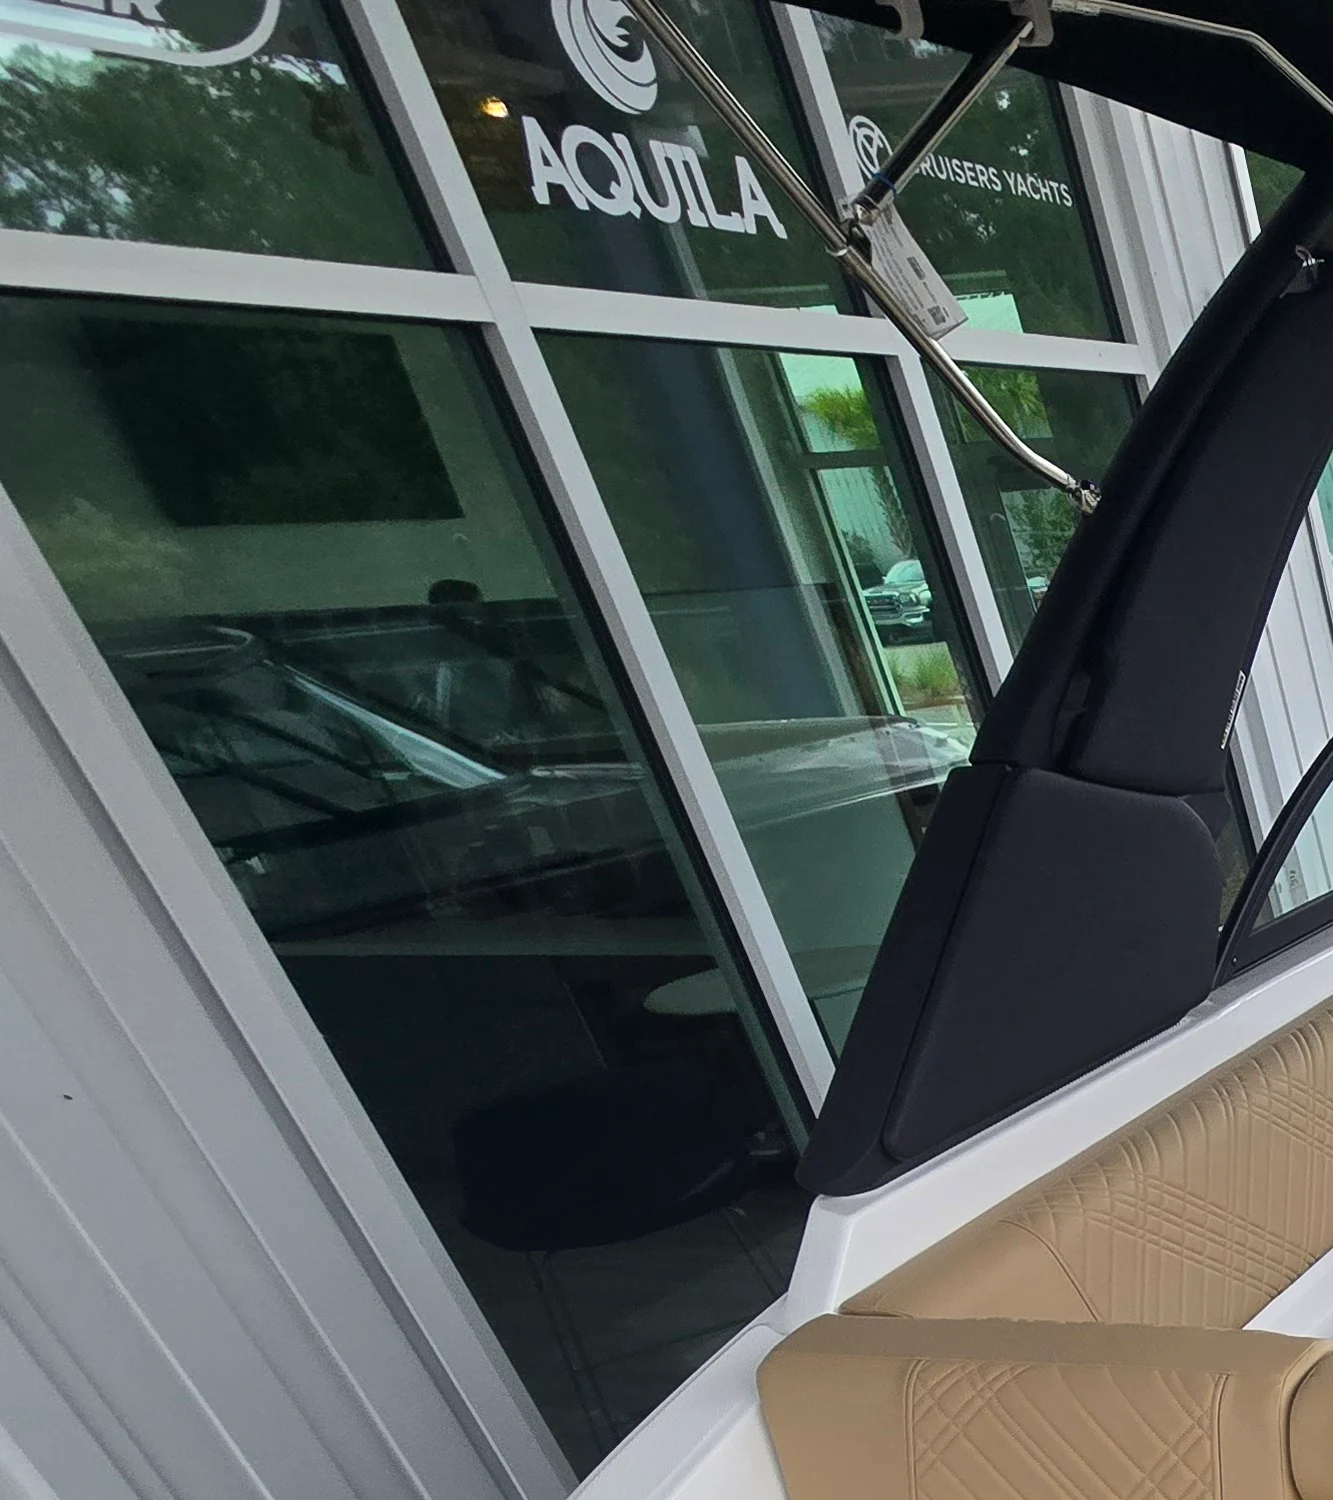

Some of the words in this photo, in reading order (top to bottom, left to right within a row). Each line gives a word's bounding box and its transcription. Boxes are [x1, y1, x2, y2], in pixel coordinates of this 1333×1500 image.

[522, 115, 788, 240] AQUILA
[914, 153, 1002, 192] RUISERS
[1003, 169, 1073, 208] YACHTS
